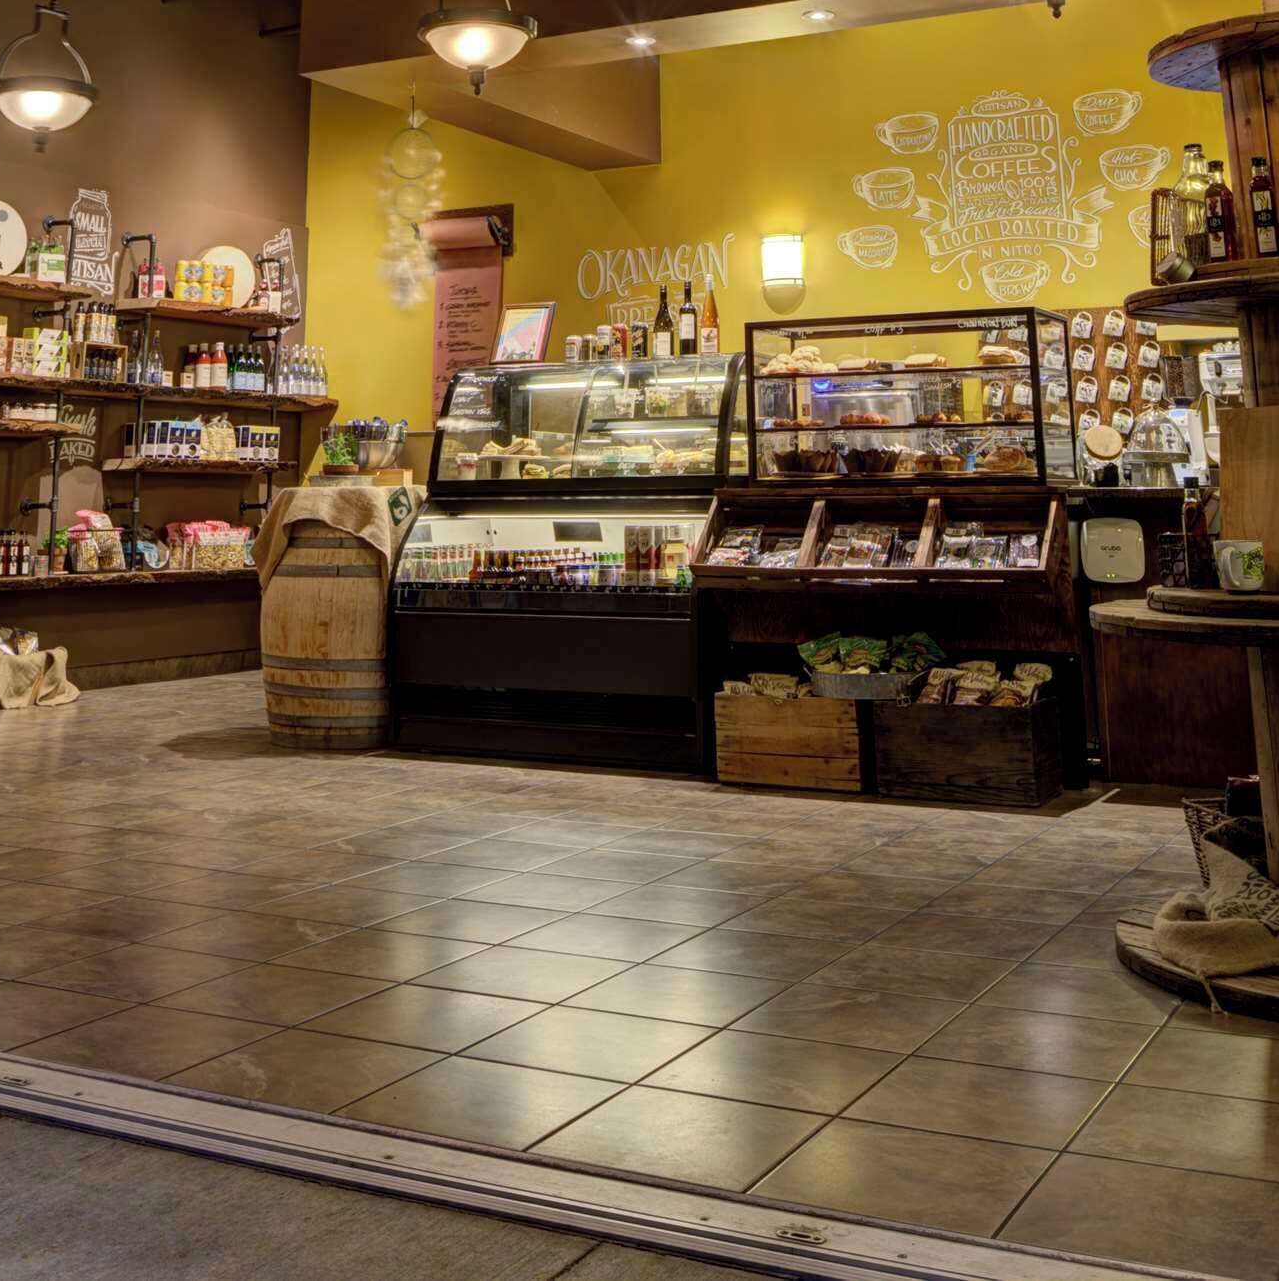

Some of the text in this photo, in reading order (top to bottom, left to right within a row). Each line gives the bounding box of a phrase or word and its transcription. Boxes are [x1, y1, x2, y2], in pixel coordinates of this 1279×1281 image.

[950, 114, 1055, 156] HANDCRAFTED
[955, 146, 1057, 179] COFFEES
[974, 144, 1033, 158] ORGANIC
[75, 212, 107, 233] SMALL
[942, 220, 1079, 250] LOCAL ROASTED
[577, 232, 736, 300] OKANAGAN
[1000, 245, 1043, 257] NITRO
